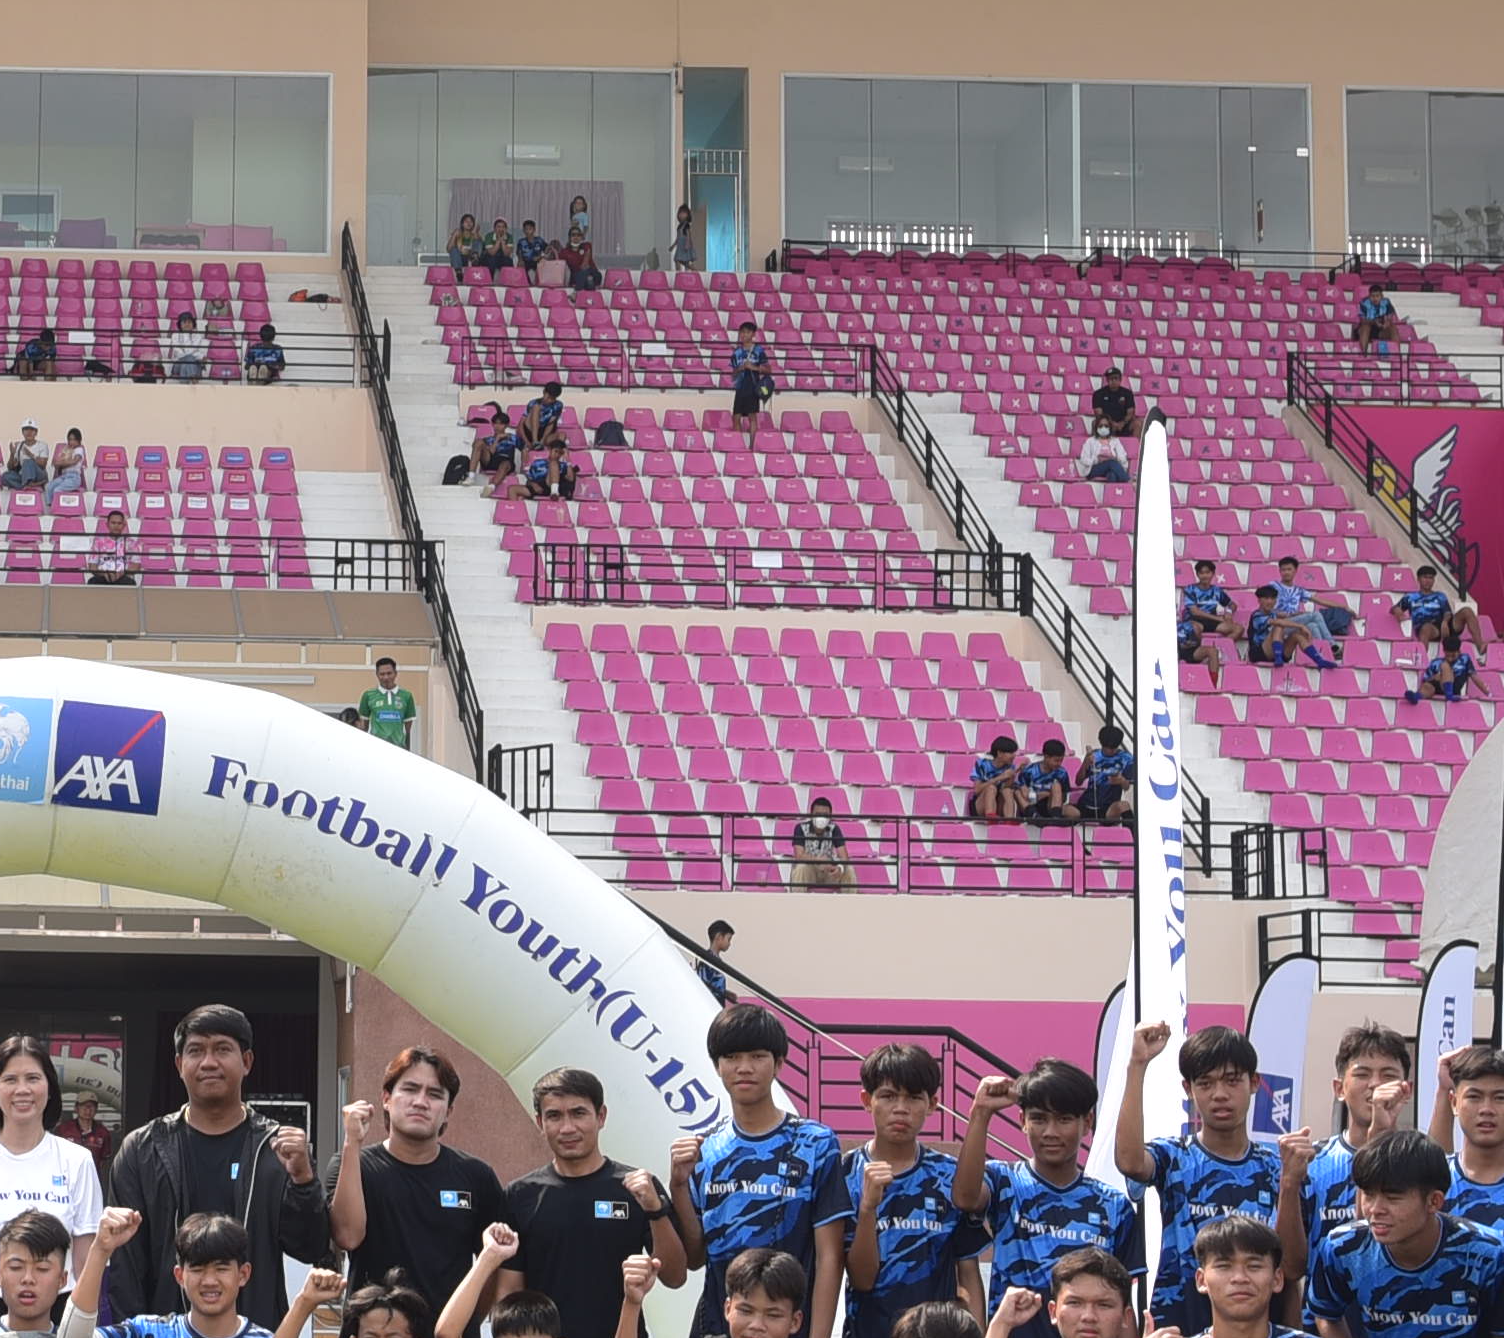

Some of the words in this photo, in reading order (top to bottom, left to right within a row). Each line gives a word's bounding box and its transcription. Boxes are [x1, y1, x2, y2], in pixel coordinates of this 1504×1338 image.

[54, 754, 141, 805] AXA
[201, 754, 459, 888] Football
[1272, 1087, 1291, 1135] AXA
[704, 1181, 738, 1194] Know
[742, 1179, 768, 1194] You
[14, 1189, 41, 1202] You
[44, 1191, 70, 1203] Can
[1319, 1207, 1357, 1221] Know
[1051, 1223, 1078, 1240] You
[1080, 1230, 1107, 1244] Can
[1409, 1312, 1443, 1326] You
[1446, 1312, 1478, 1326] Can
